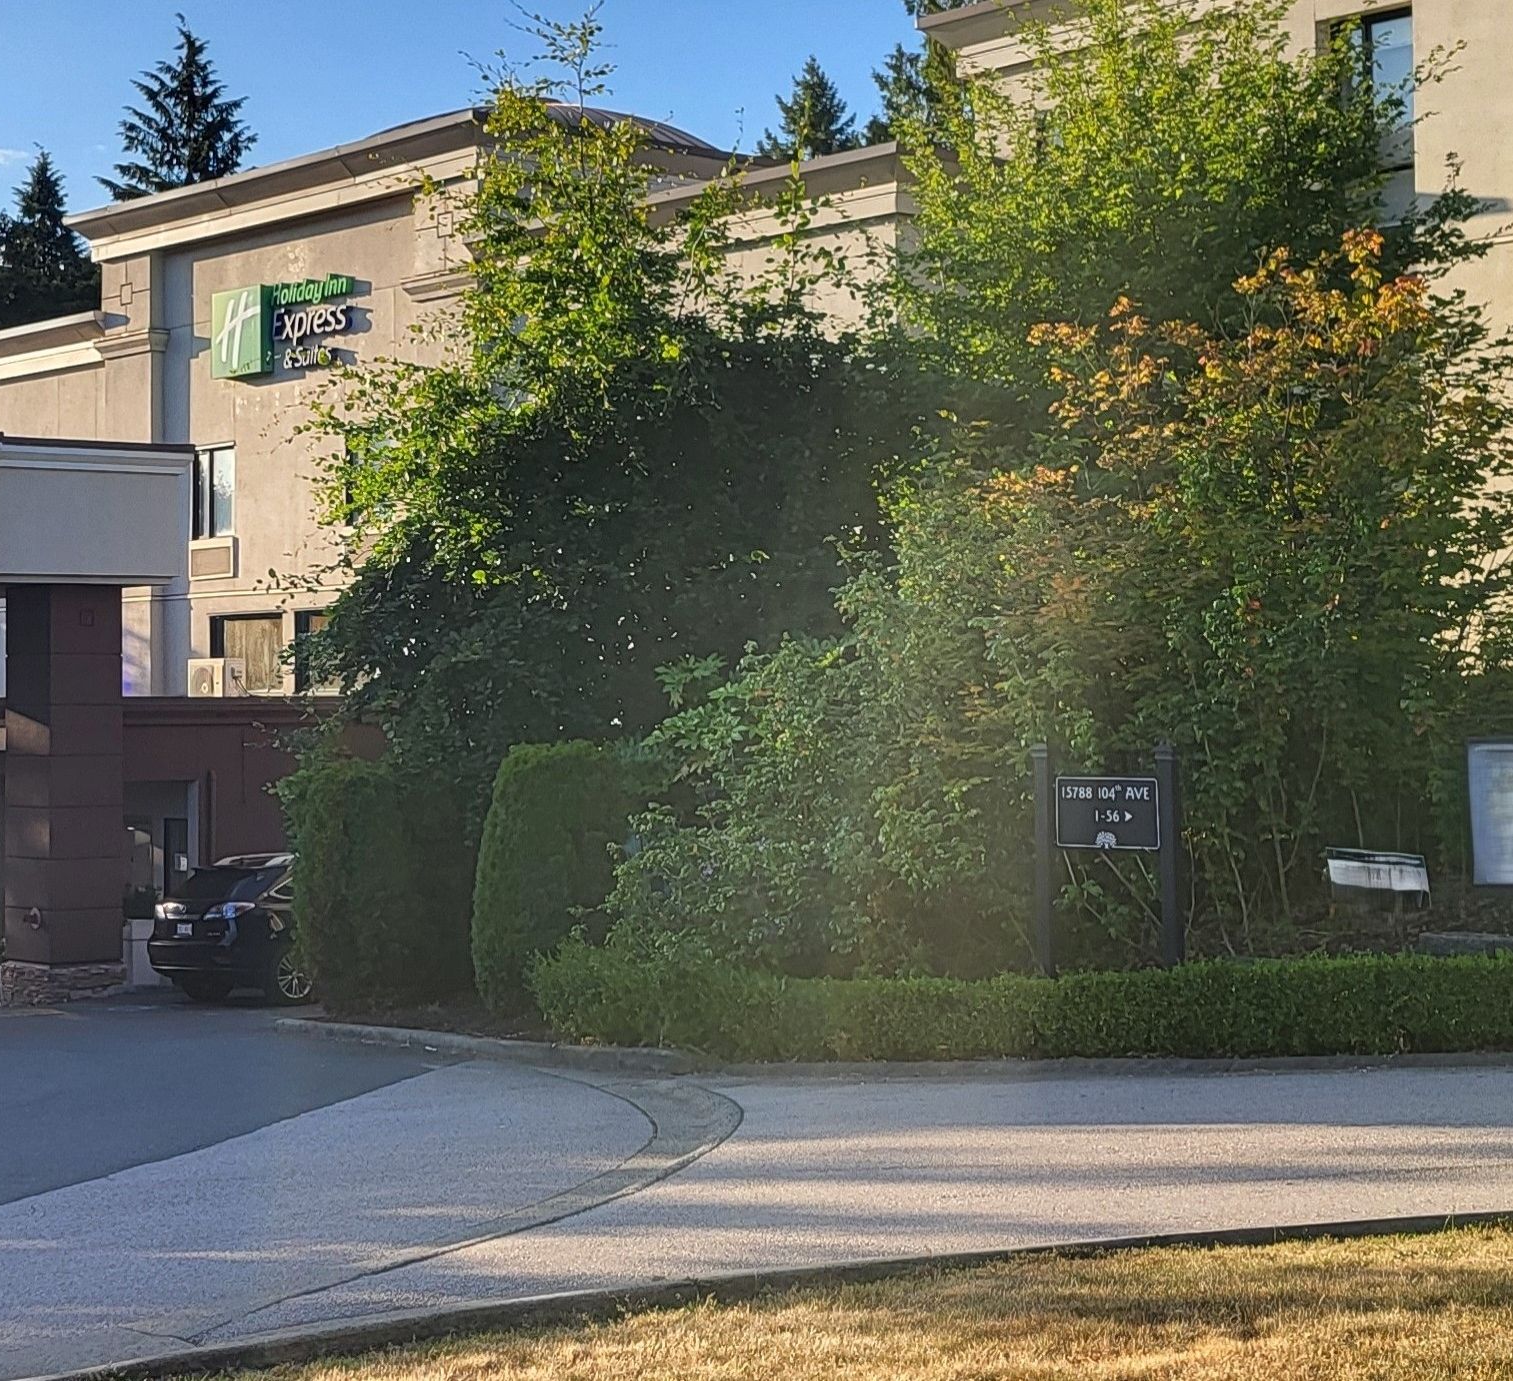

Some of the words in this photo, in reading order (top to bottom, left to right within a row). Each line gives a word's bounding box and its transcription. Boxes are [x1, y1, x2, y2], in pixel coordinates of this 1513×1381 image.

[271, 278, 323, 305] Holiday
[325, 272, 347, 296] Inn
[273, 304, 347, 346] Express
[283, 348, 293, 369] &
[1061, 786, 1093, 800] 15788
[1098, 784, 1122, 801] 104th
[1125, 786, 1150, 801] AVE
[1094, 809, 1120, 823] 1-56
